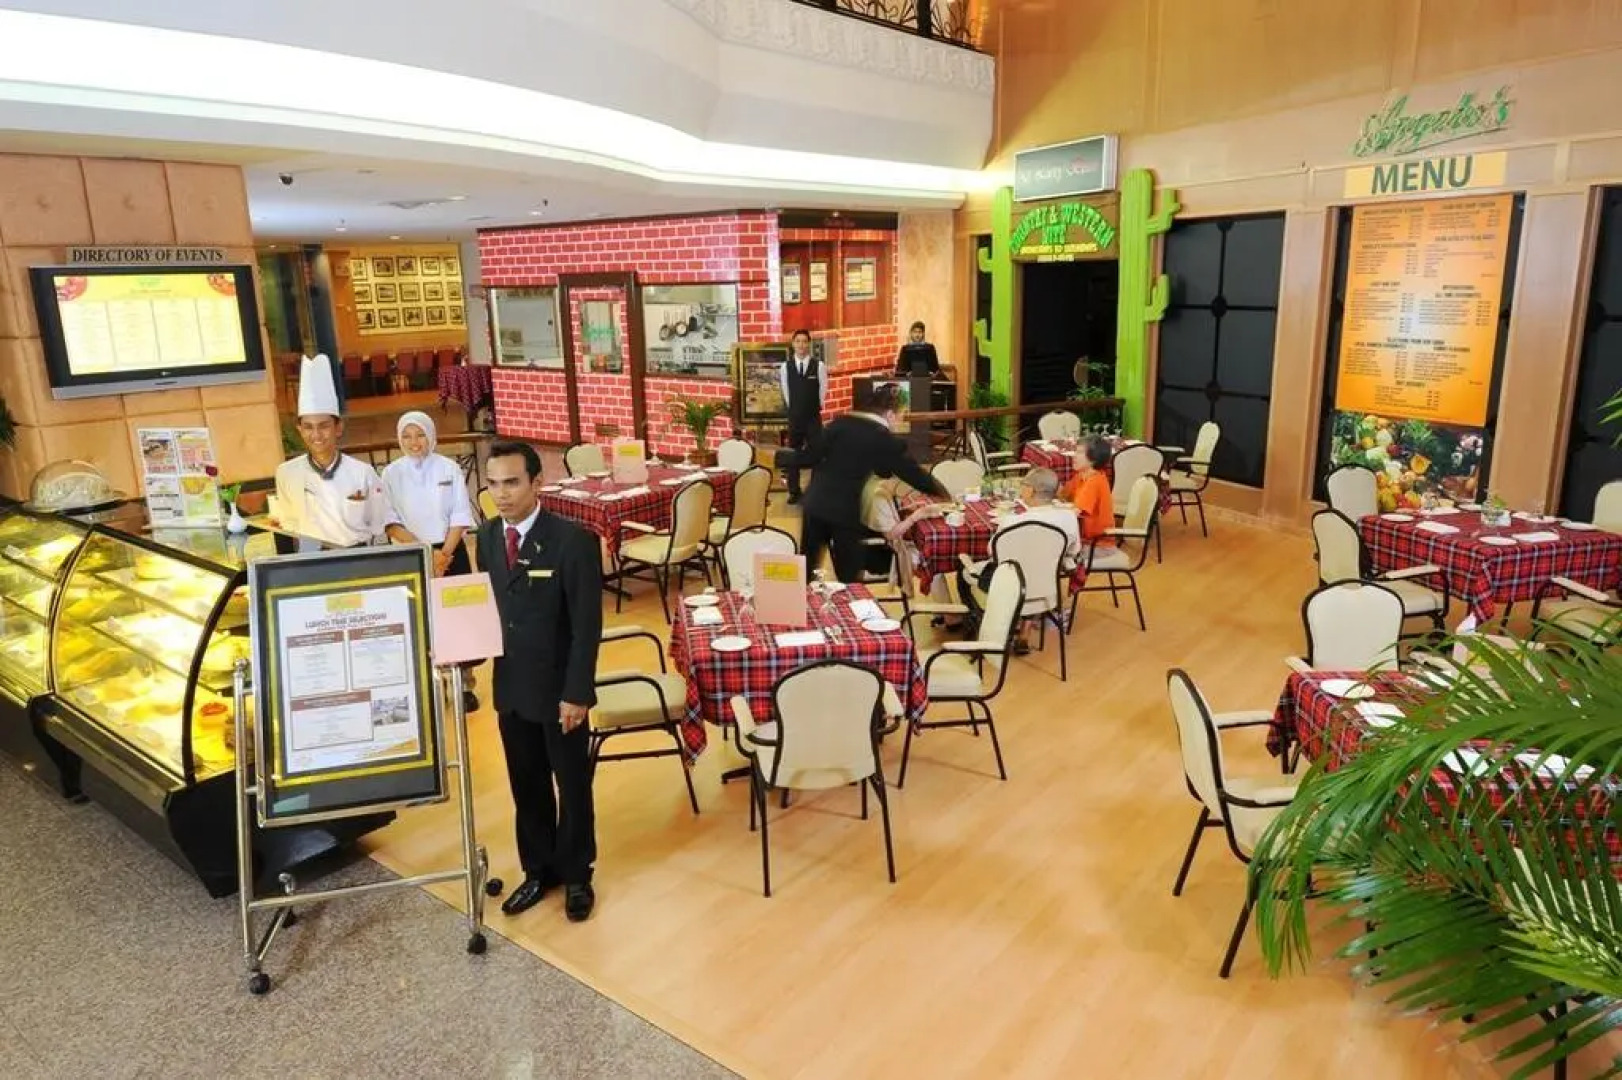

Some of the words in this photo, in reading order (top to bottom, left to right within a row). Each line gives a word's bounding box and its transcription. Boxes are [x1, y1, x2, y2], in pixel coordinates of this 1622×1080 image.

[1371, 154, 1474, 195] MENU
[1061, 202, 1116, 250] WESTERN
[72, 249, 150, 262] DIRECTORY
[155, 249, 172, 262] OF
[176, 248, 224, 262] EVENTS
[305, 619, 330, 629] LUNCH
[331, 616, 347, 625] TIME
